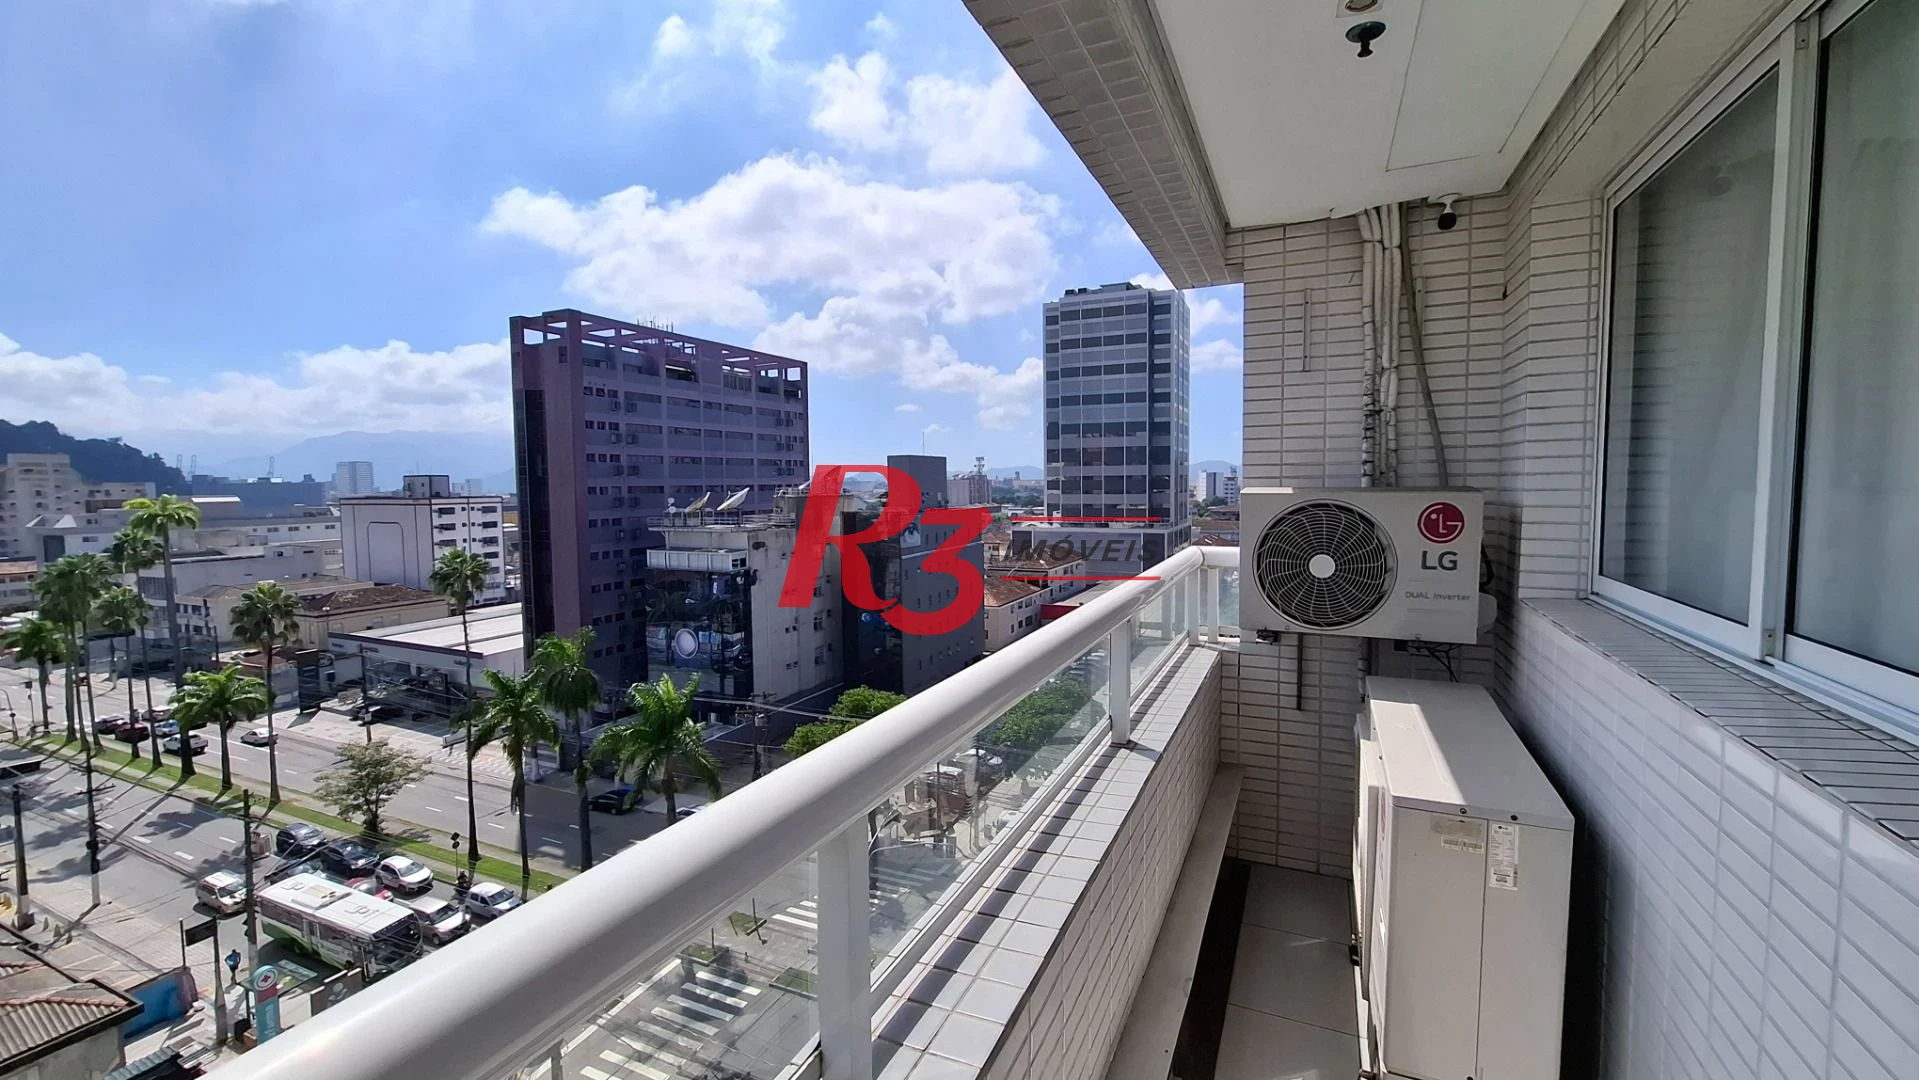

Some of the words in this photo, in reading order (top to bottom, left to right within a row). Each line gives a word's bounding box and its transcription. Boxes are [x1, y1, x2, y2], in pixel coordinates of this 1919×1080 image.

[1421, 550, 1458, 571] LG
[1405, 591, 1430, 600] DUAL
[1433, 592, 1471, 601] Inverter
